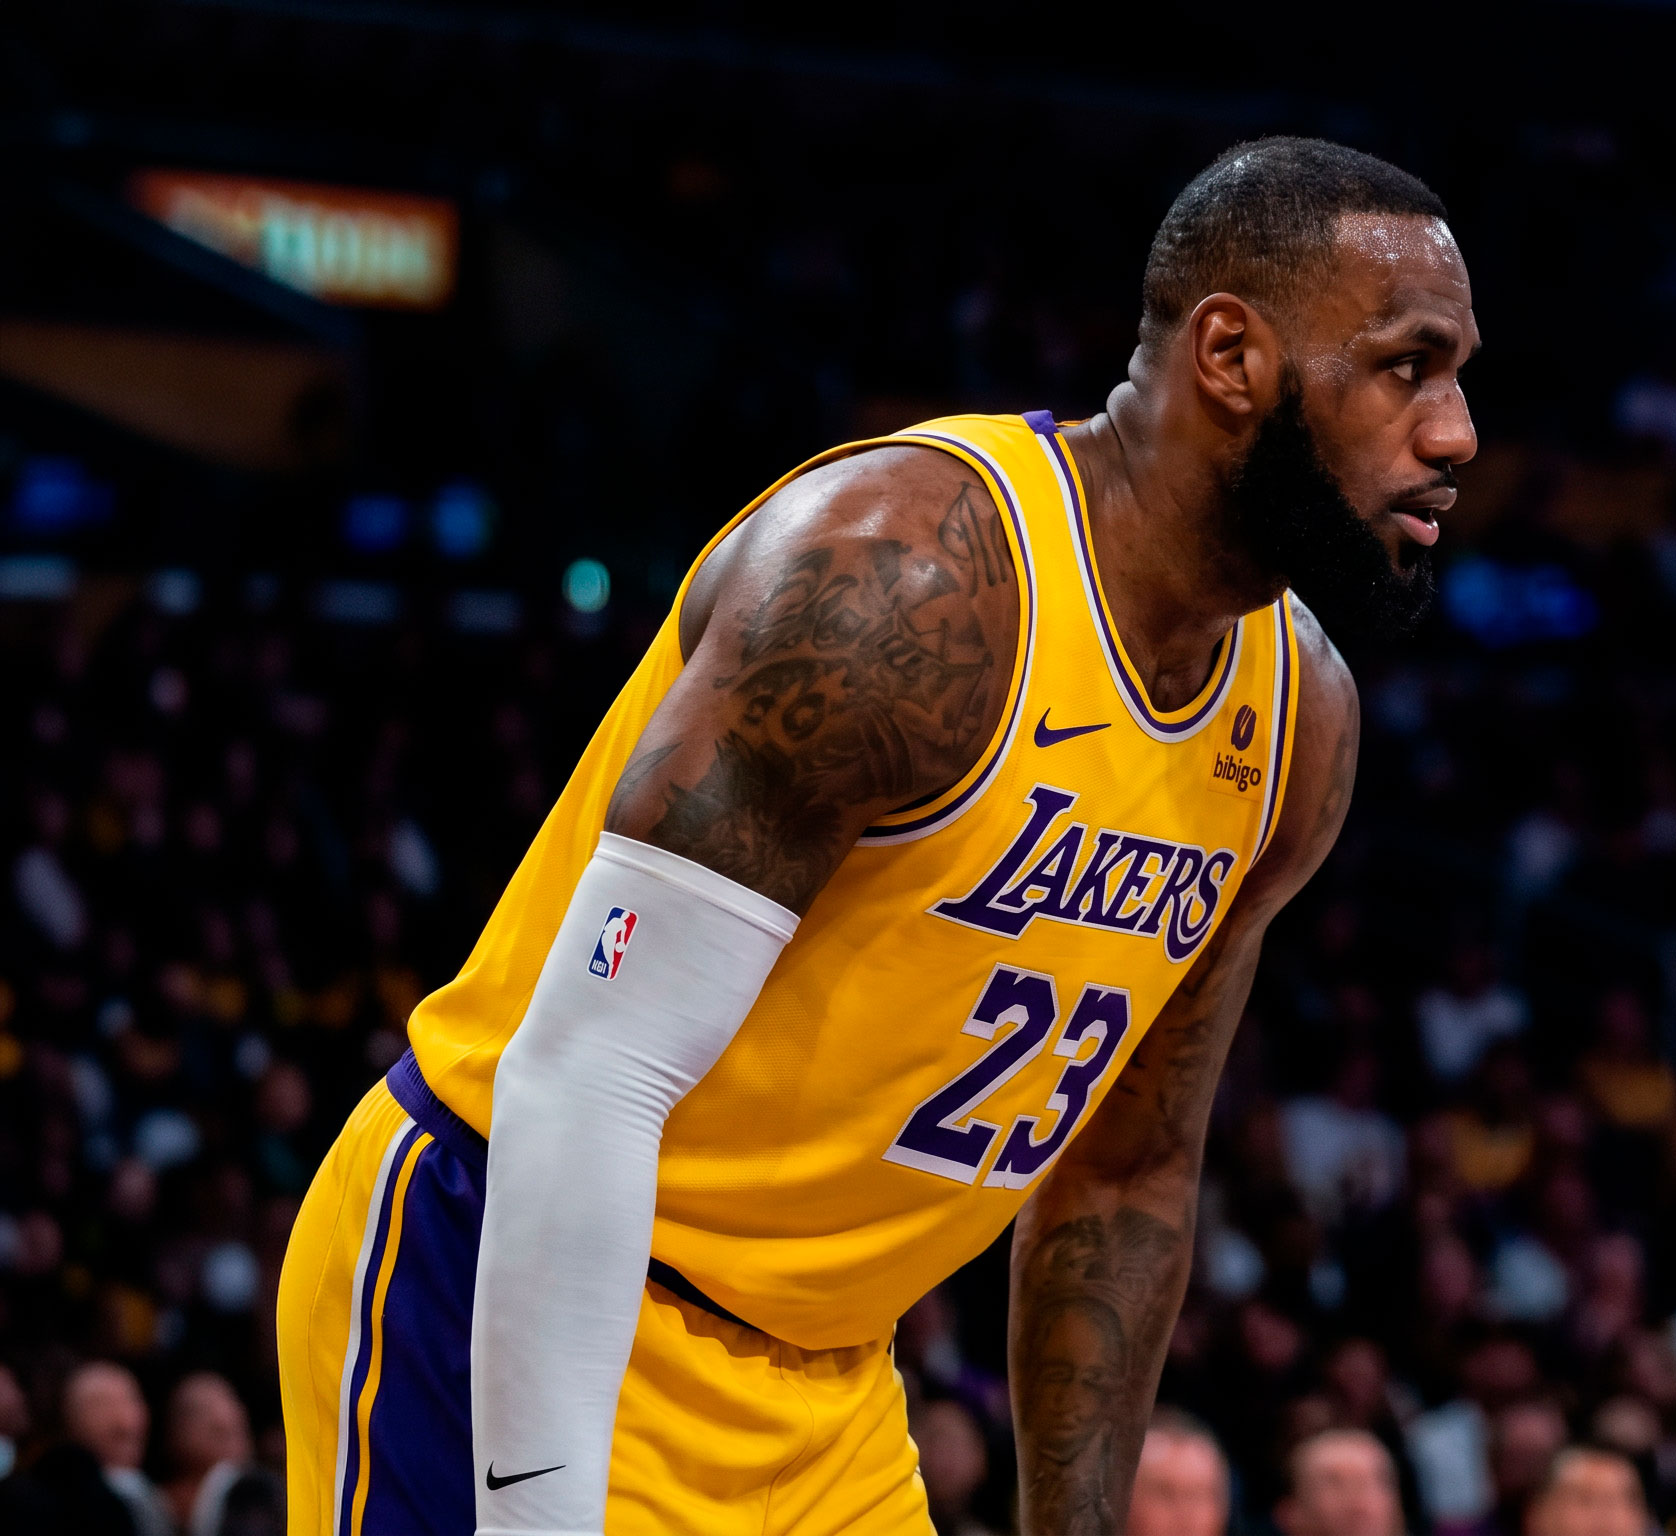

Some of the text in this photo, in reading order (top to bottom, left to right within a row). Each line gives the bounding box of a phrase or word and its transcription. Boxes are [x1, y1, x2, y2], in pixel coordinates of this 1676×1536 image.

[1213, 752, 1262, 792] bibigo
[926, 782, 1237, 963] LAKERS
[882, 962, 1132, 1189] 23
